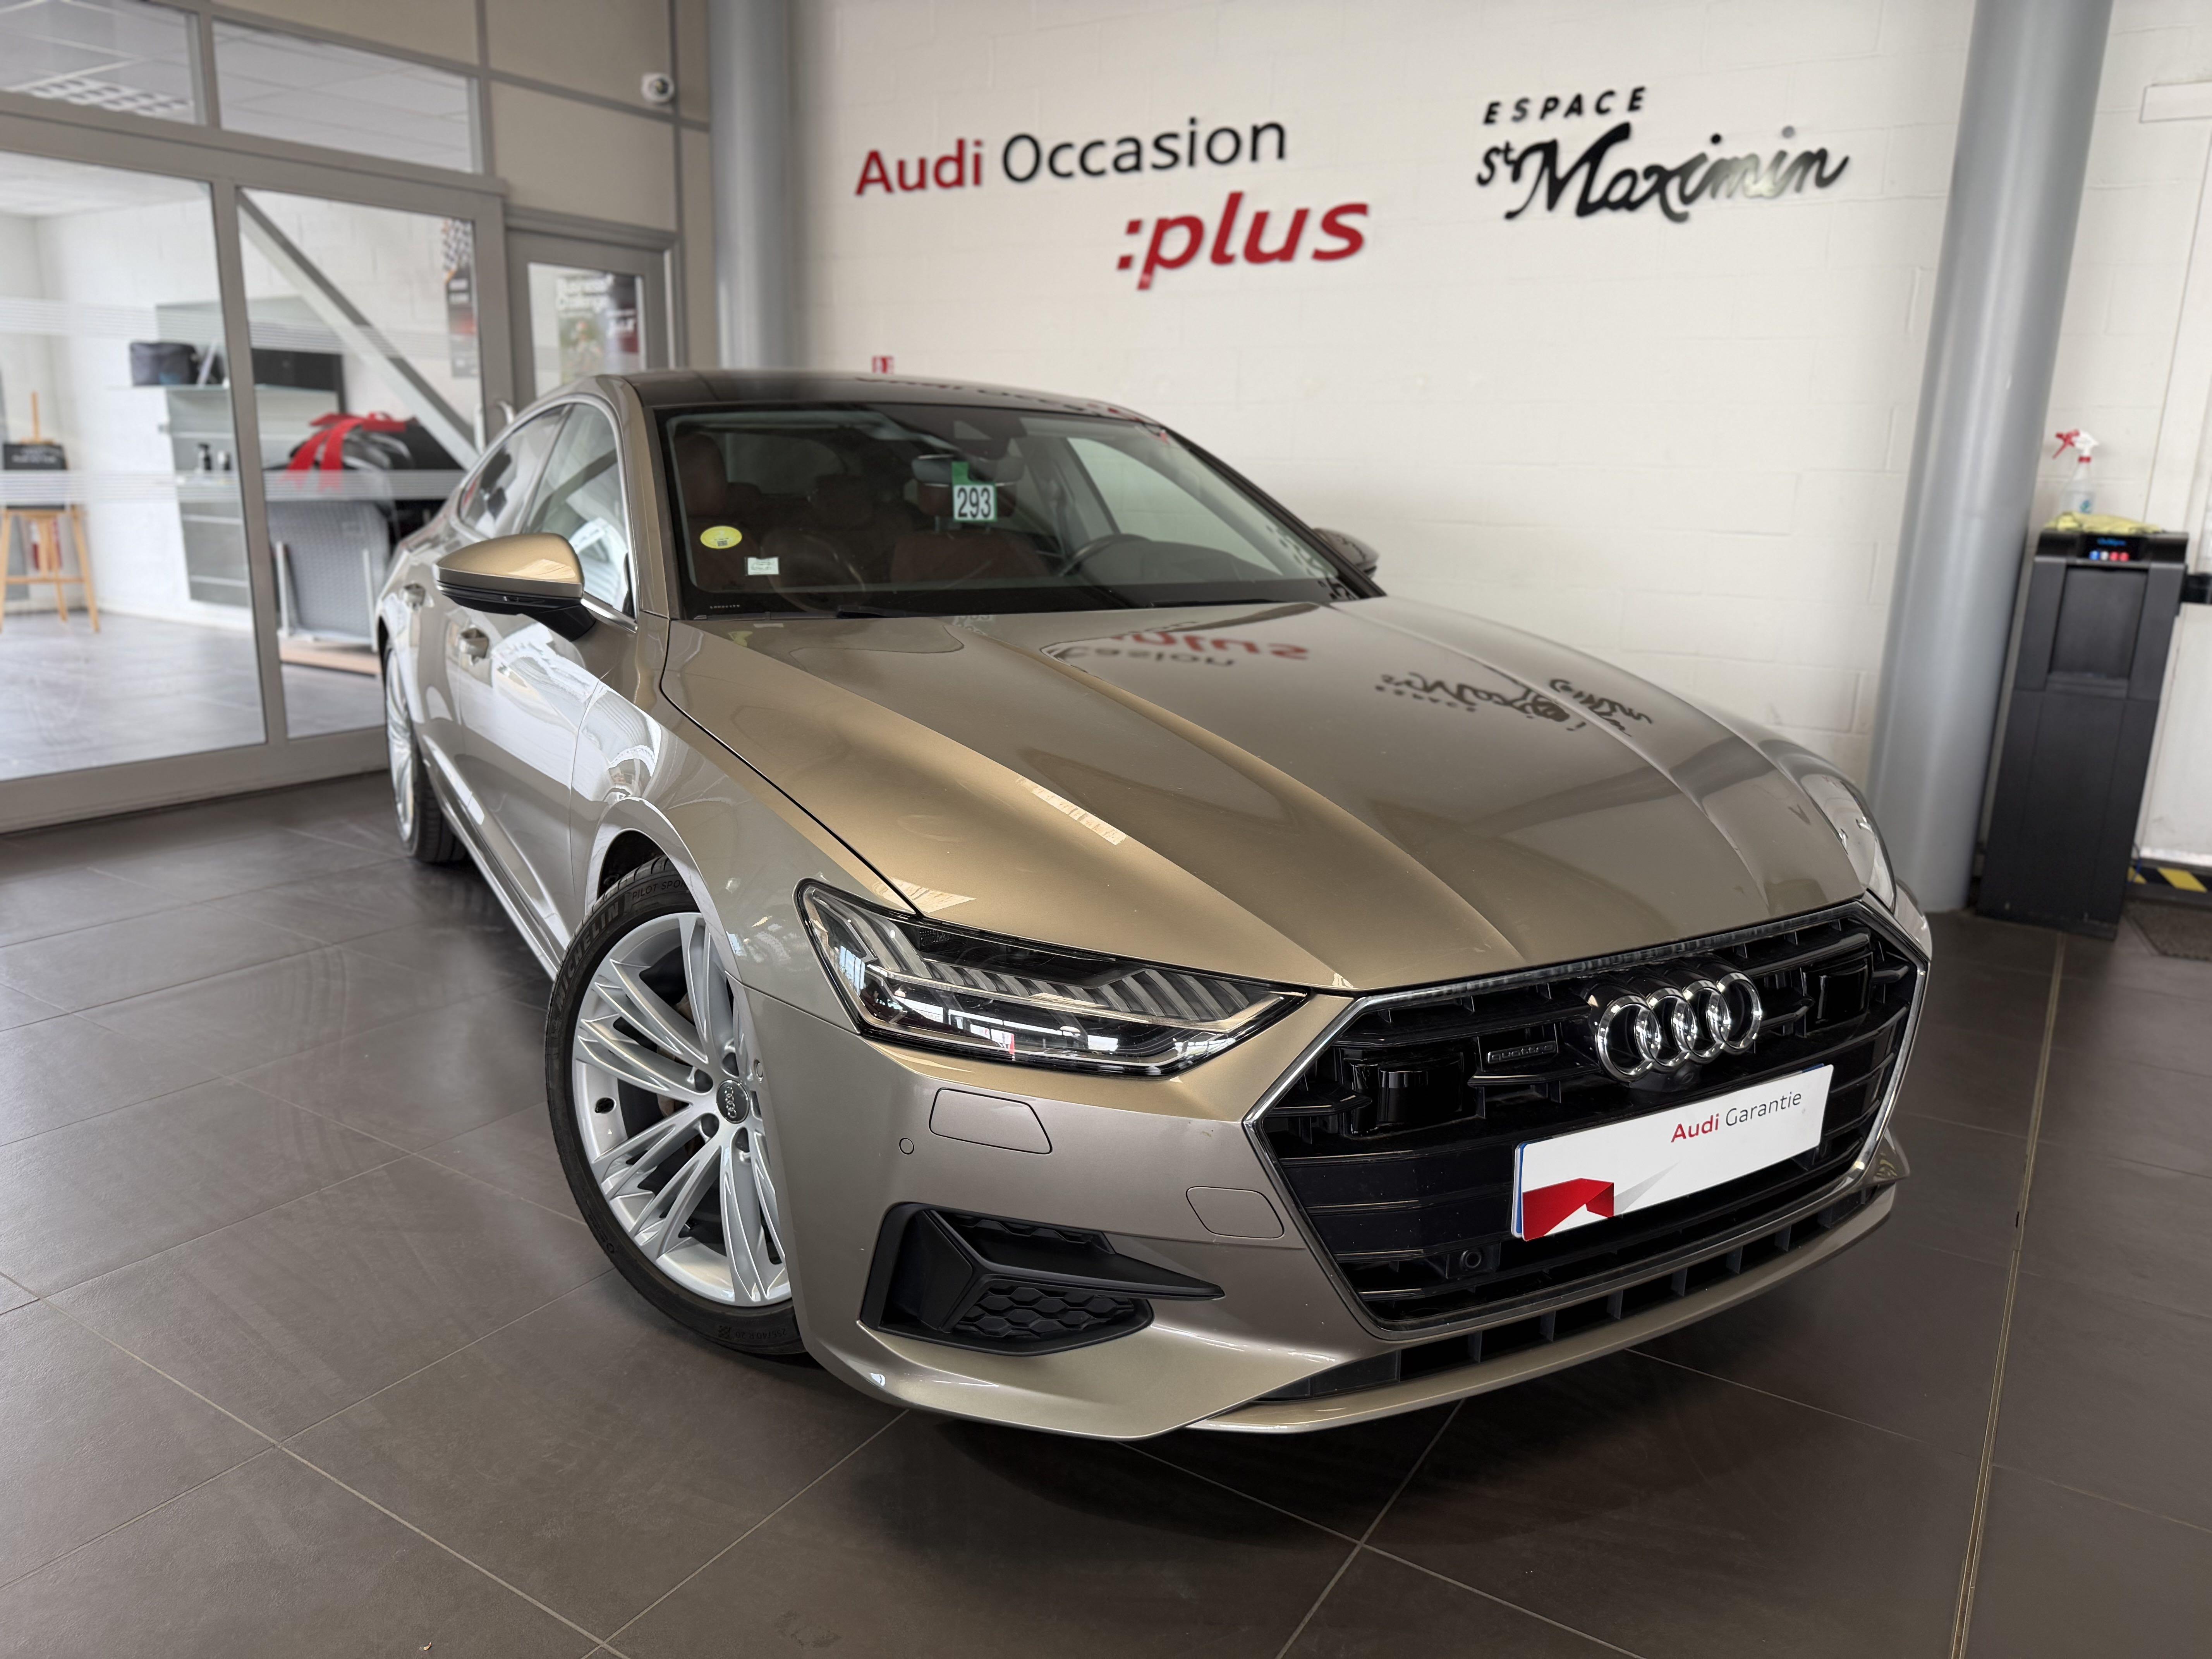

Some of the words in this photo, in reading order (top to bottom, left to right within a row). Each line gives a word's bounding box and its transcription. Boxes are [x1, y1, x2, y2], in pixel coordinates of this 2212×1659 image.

[1482, 85, 1646, 125] ESPACE
[856, 138, 981, 195] Audi
[1001, 116, 1286, 184] Occasion
[1504, 121, 1851, 224] Maximin
[958, 487, 991, 518] 293
[632, 884, 658, 900] PILOT
[555, 901, 620, 1012] MICHELIN
[1491, 1044, 1553, 1061] quattro
[1671, 1113, 1719, 1143] Audi
[1726, 1091, 1802, 1126] Garantie
